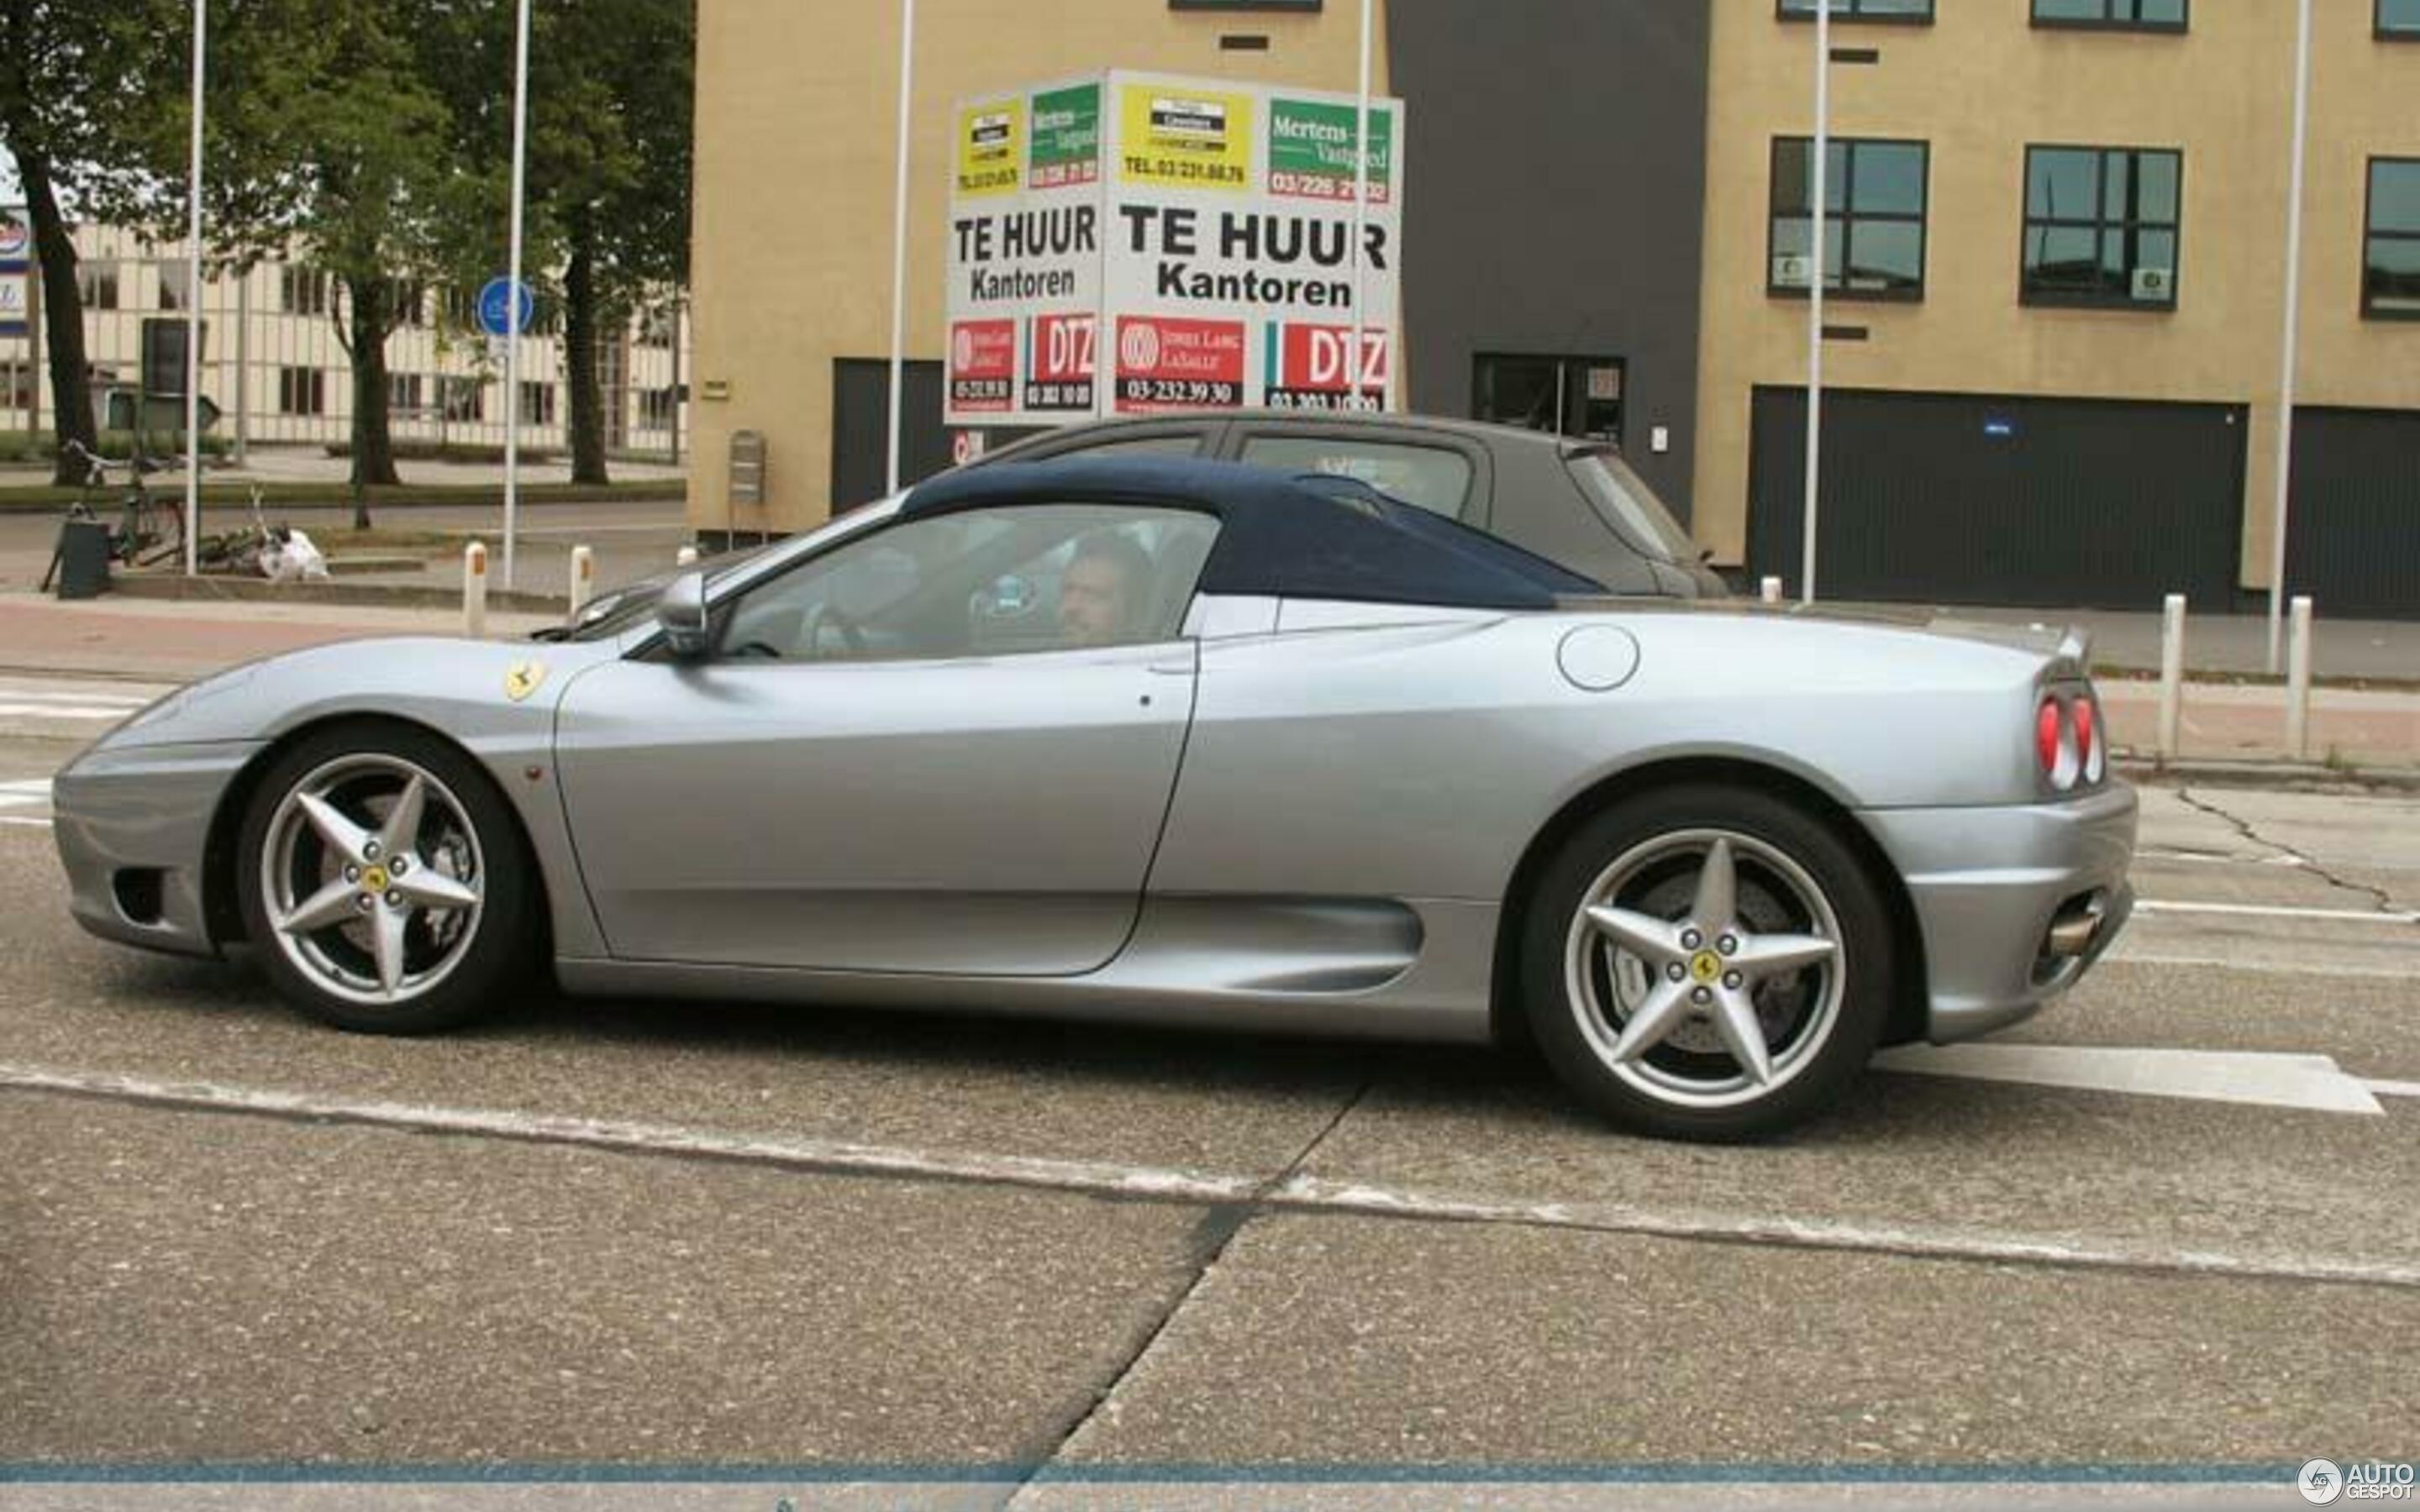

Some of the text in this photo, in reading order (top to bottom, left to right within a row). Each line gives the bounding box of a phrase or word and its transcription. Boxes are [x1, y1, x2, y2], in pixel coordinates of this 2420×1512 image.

[1273, 115, 1348, 143] Mertens
[1316, 142, 1386, 170] Vastged
[955, 205, 1097, 262] TE HUUR
[1119, 204, 1387, 270] TE HUUR
[971, 267, 1075, 302] Kantoren
[1157, 261, 1351, 307] Kantoren
[1050, 318, 1095, 374] DTZ
[1309, 328, 1386, 385] DTZ
